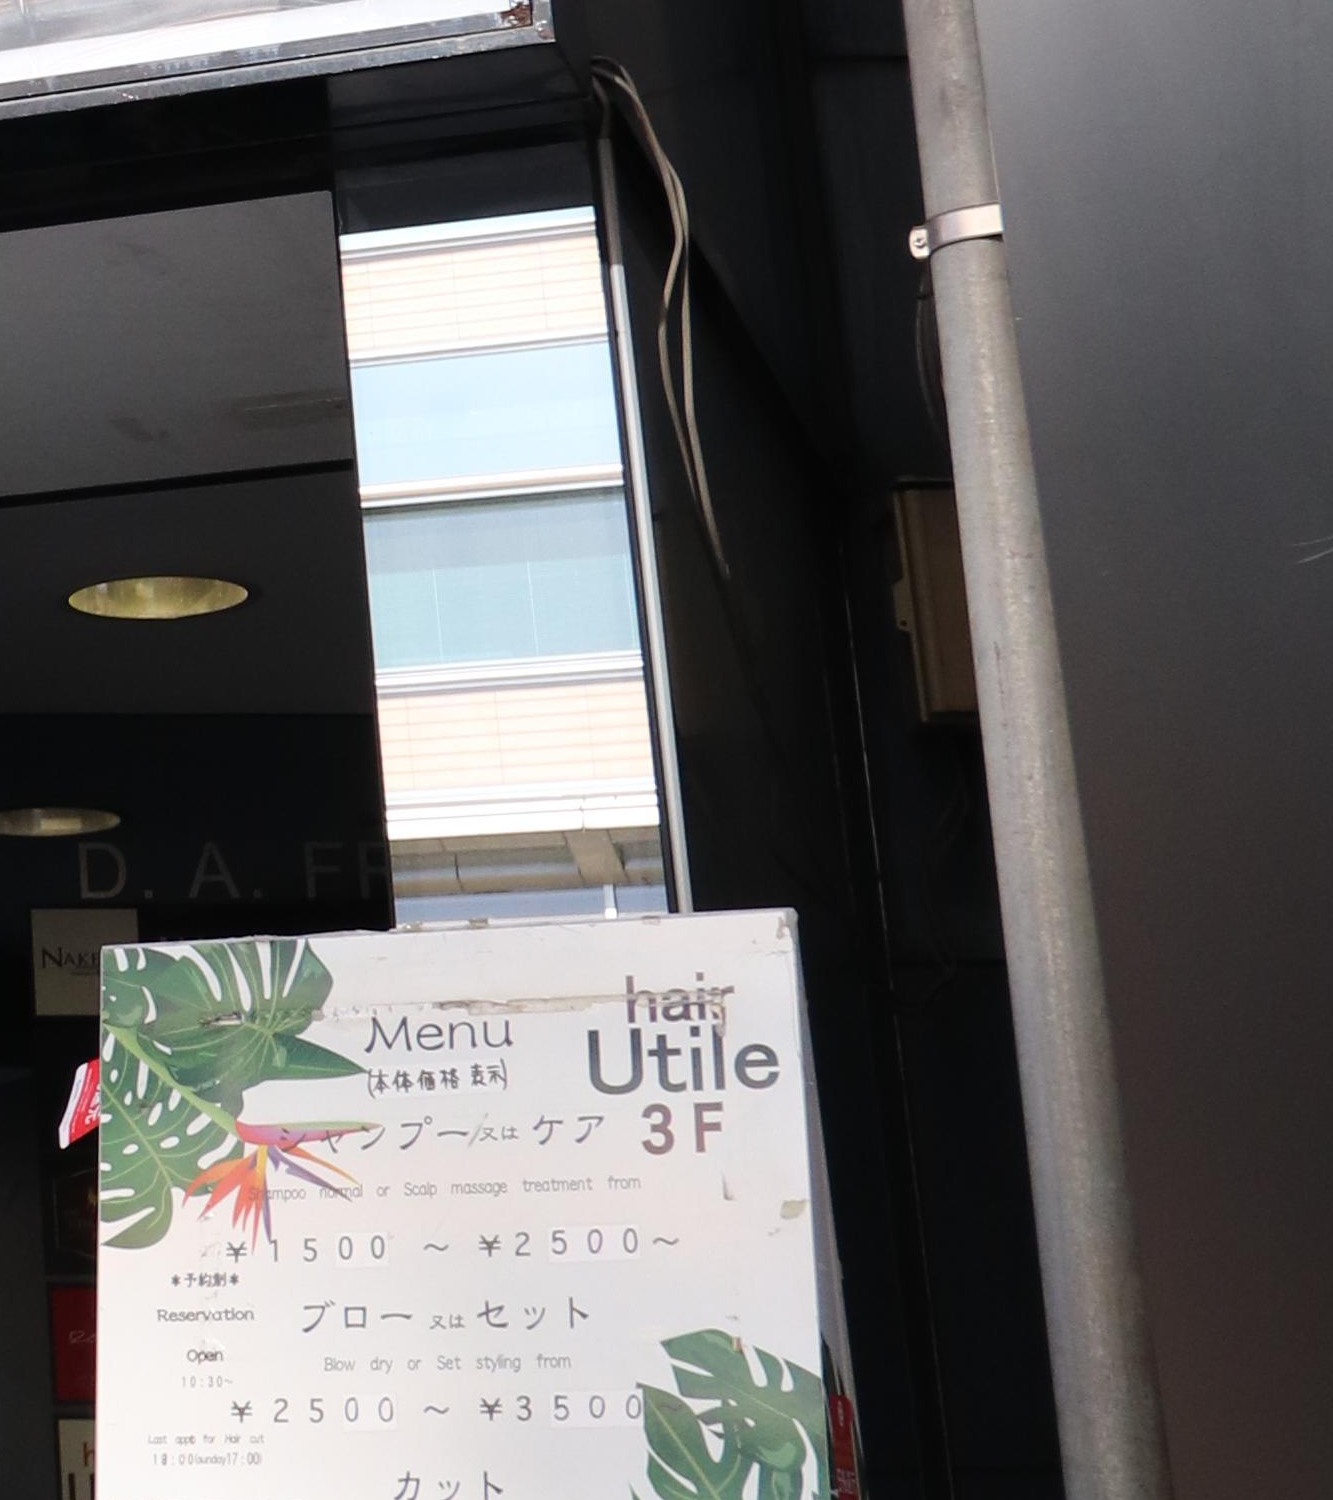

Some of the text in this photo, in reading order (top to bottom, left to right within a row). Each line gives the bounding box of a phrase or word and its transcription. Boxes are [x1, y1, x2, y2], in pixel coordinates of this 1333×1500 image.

[625, 971, 735, 1024] hair
[364, 1014, 514, 1054] Menu
[586, 1025, 781, 1096] Utile
[640, 1101, 724, 1156] 3F
[376, 1184, 391, 1198] or
[403, 1180, 438, 1199] Scalp
[450, 1179, 508, 1198] massage
[522, 1177, 593, 1194] treatment
[607, 1175, 642, 1191] from
[156, 1307, 255, 1324] Reservation
[186, 1348, 224, 1365] Open
[324, 1353, 573, 1375] Blow dry or Set styling from
